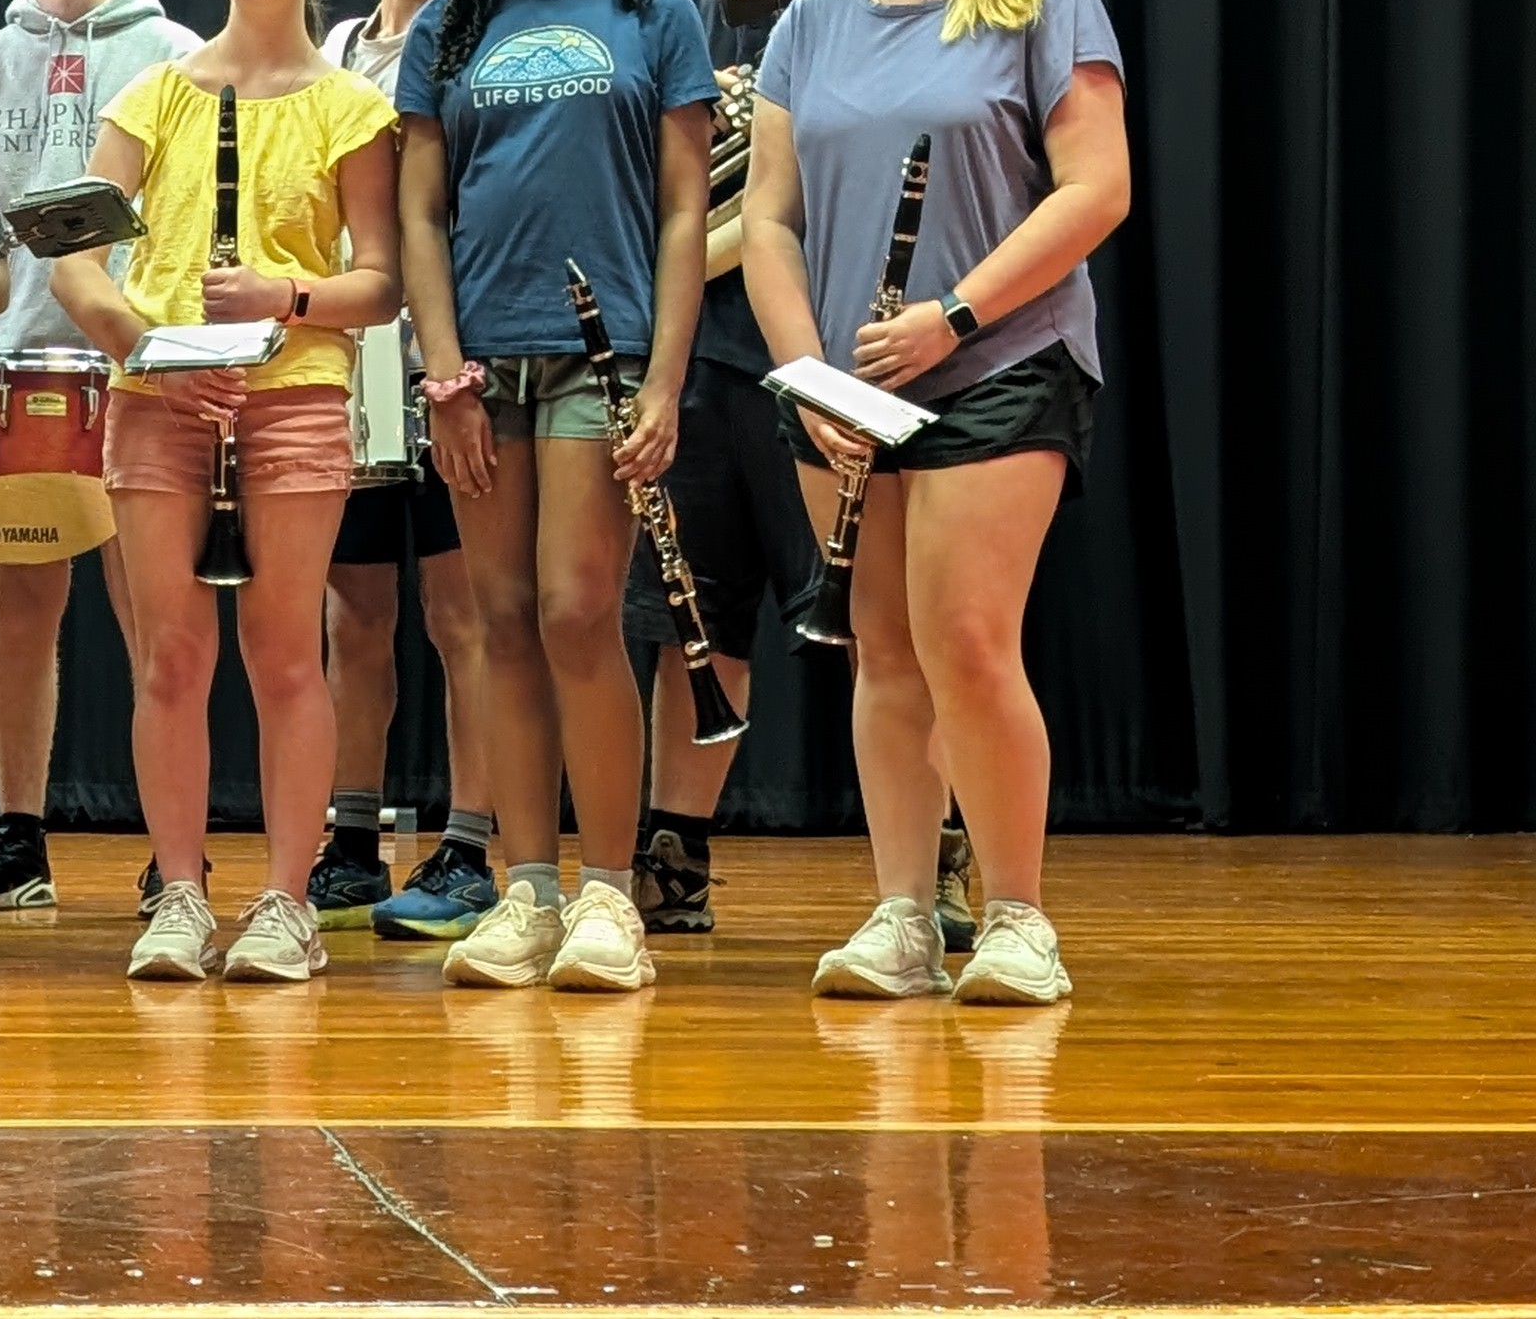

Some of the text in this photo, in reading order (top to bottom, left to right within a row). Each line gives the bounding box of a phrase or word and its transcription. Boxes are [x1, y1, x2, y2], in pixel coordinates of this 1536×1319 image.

[525, 86, 544, 103] IS
[547, 78, 611, 99] GOOD
[2, 527, 59, 543] YAMAHA
